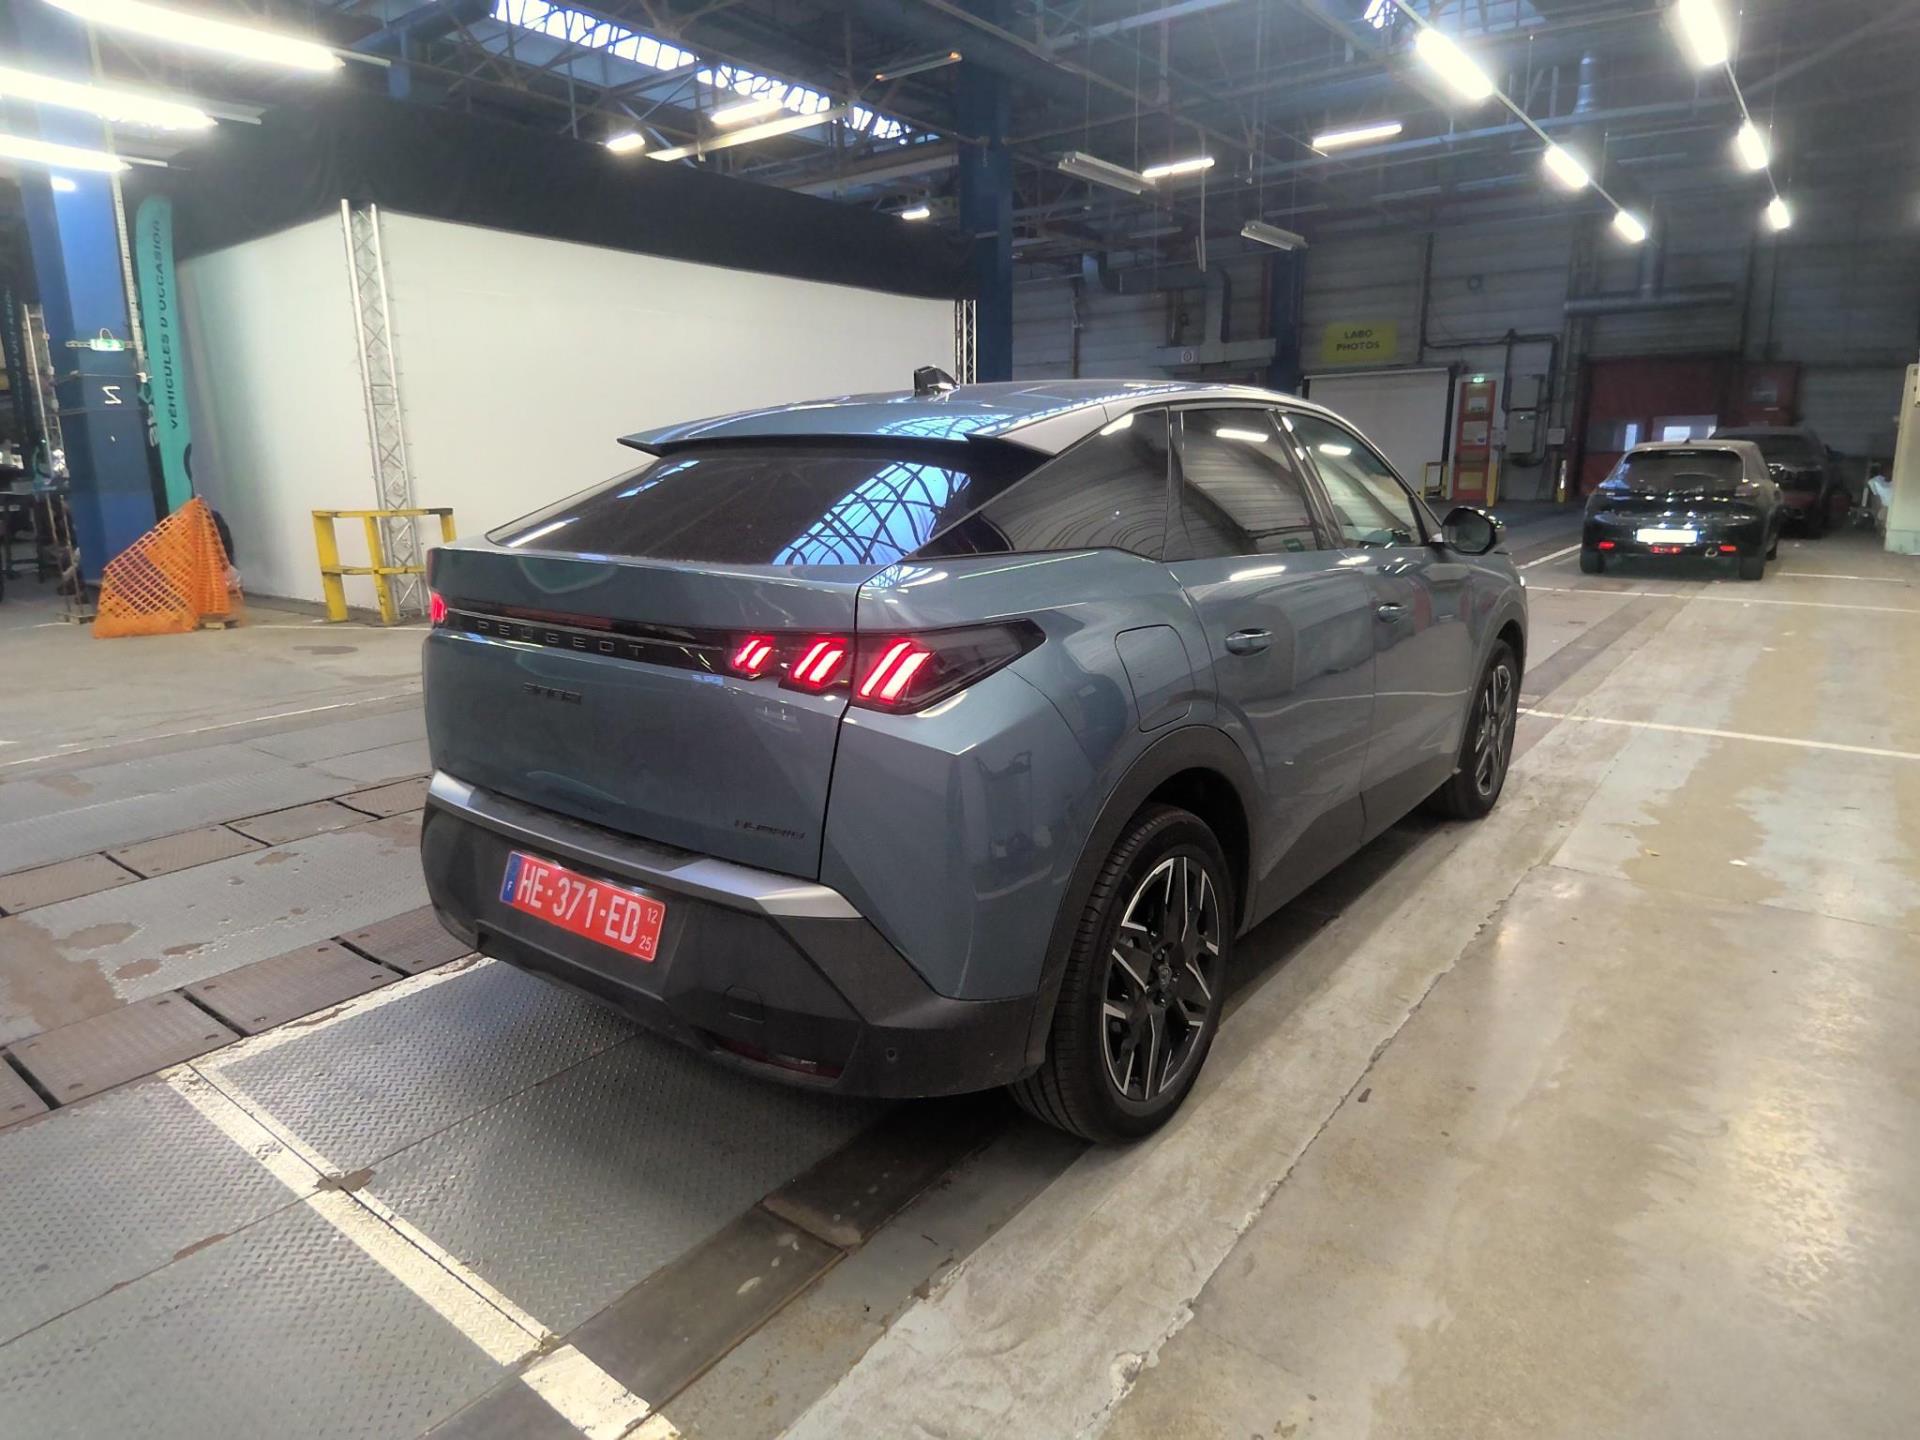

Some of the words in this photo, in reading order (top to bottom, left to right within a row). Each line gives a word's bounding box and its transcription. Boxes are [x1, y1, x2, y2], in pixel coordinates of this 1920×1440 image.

[1343, 329, 1374, 340] LABO
[1336, 341, 1380, 352] PHOTOS
[475, 618, 645, 657] PEUGEOT
[646, 906, 659, 925] 12
[638, 935, 652, 951] 25
